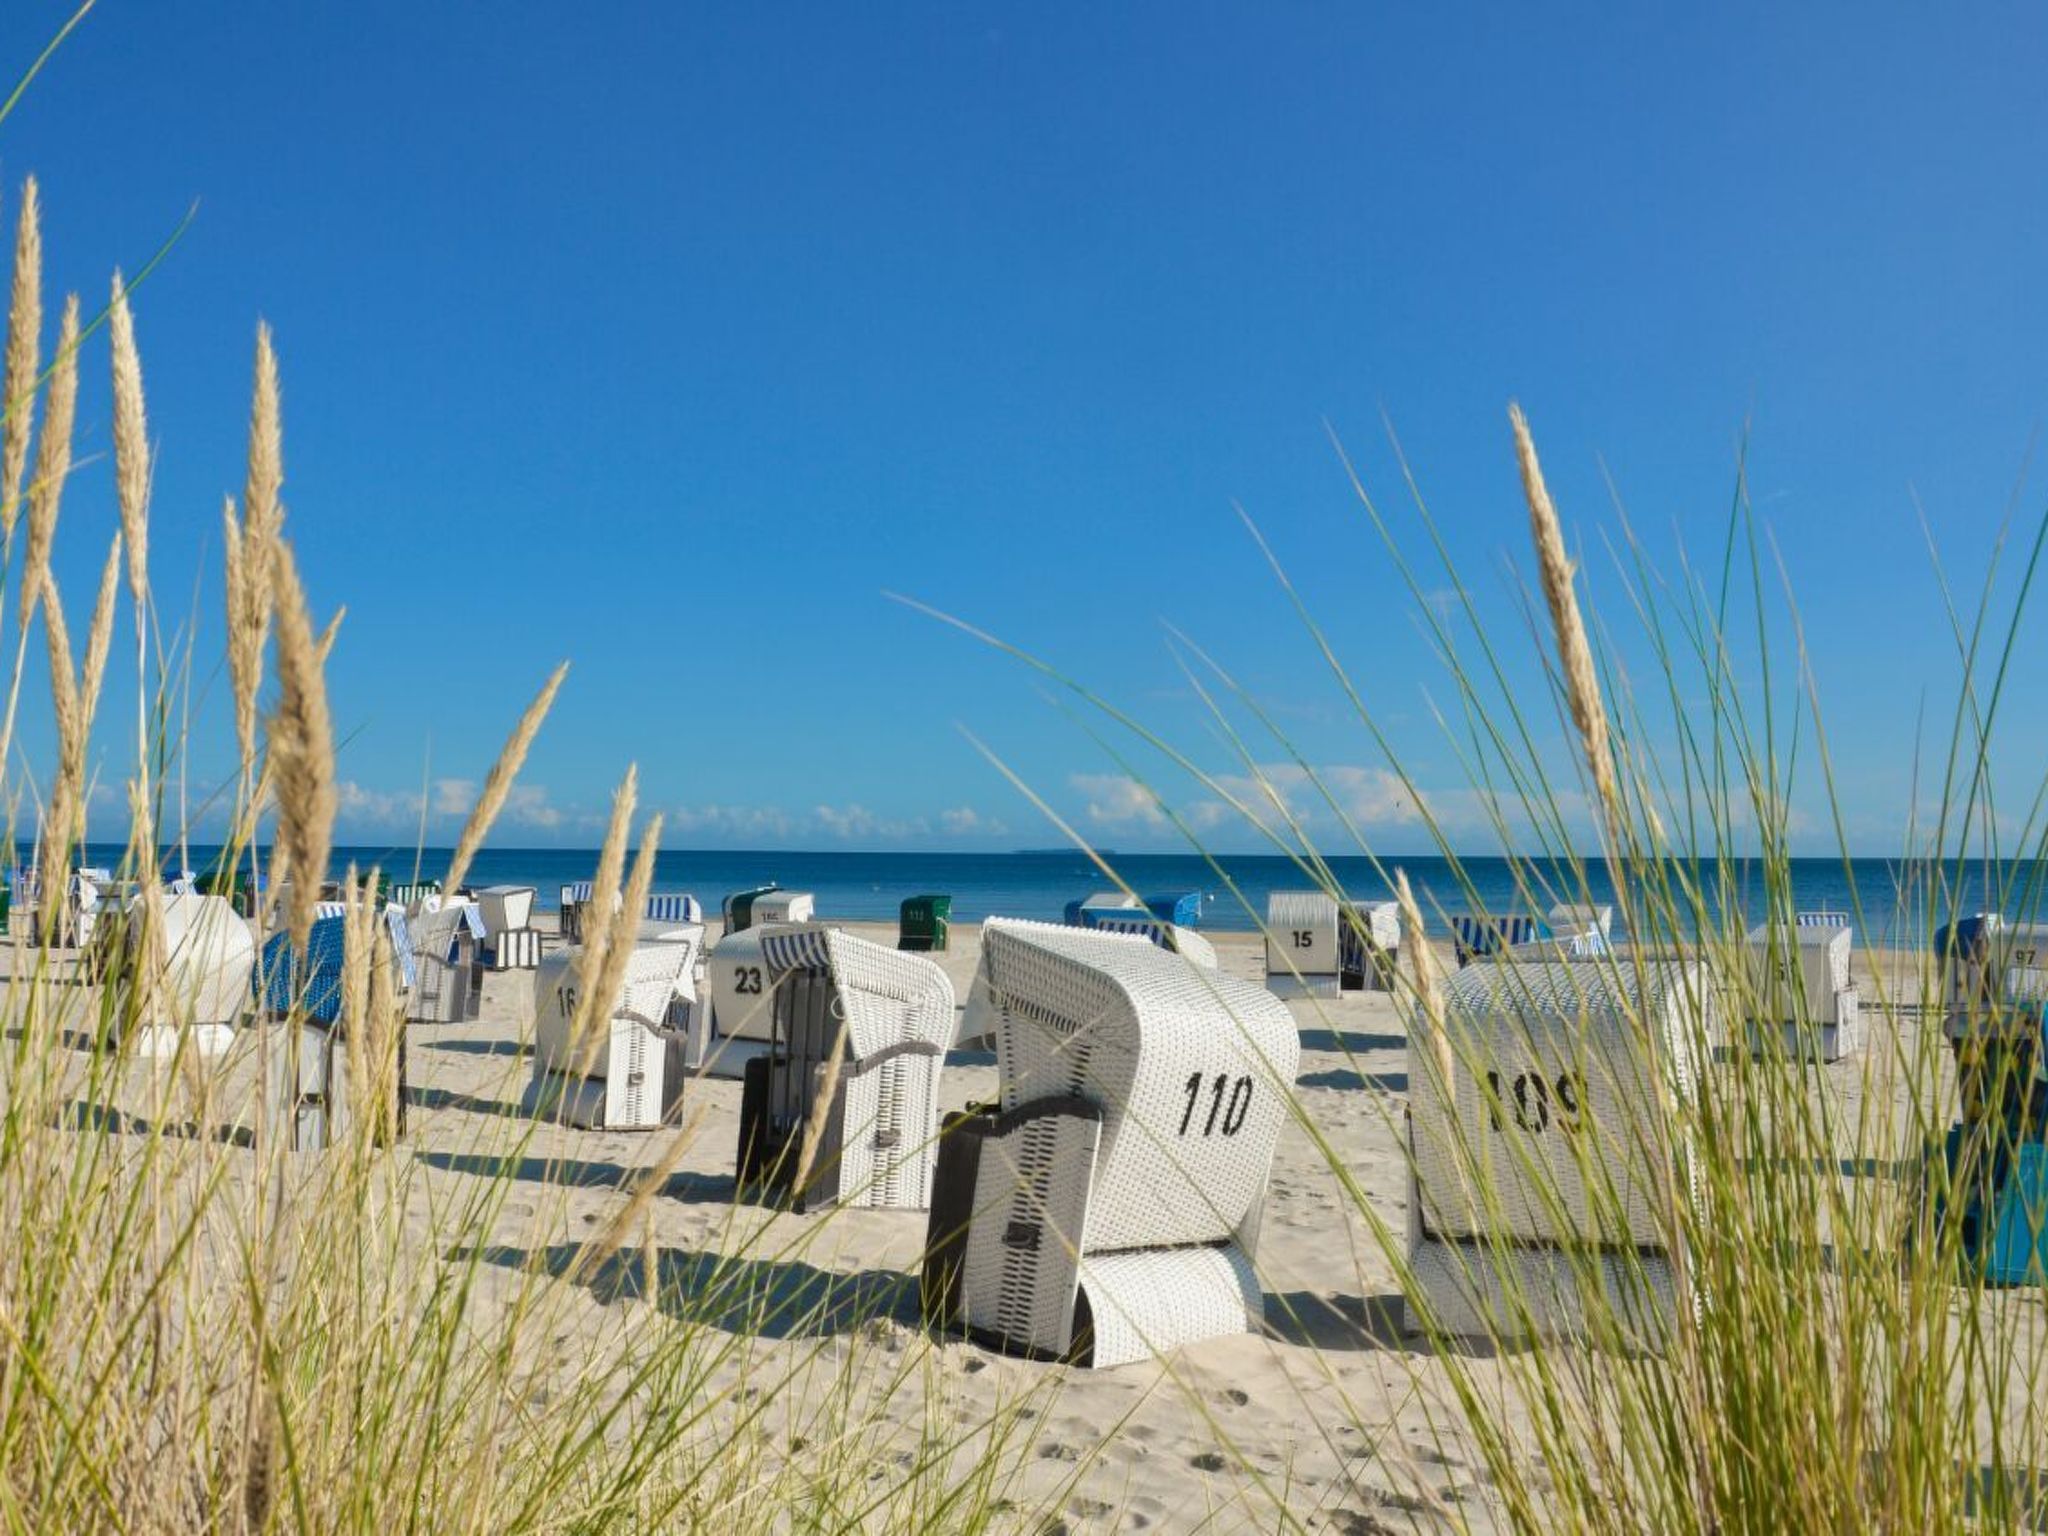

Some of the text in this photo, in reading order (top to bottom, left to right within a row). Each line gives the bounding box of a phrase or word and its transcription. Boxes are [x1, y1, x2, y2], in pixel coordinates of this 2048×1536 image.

[1292, 931, 1313, 948] 15
[2015, 949, 2036, 966] 97
[735, 966, 762, 994] 23
[1179, 1072, 1253, 1136] 110
